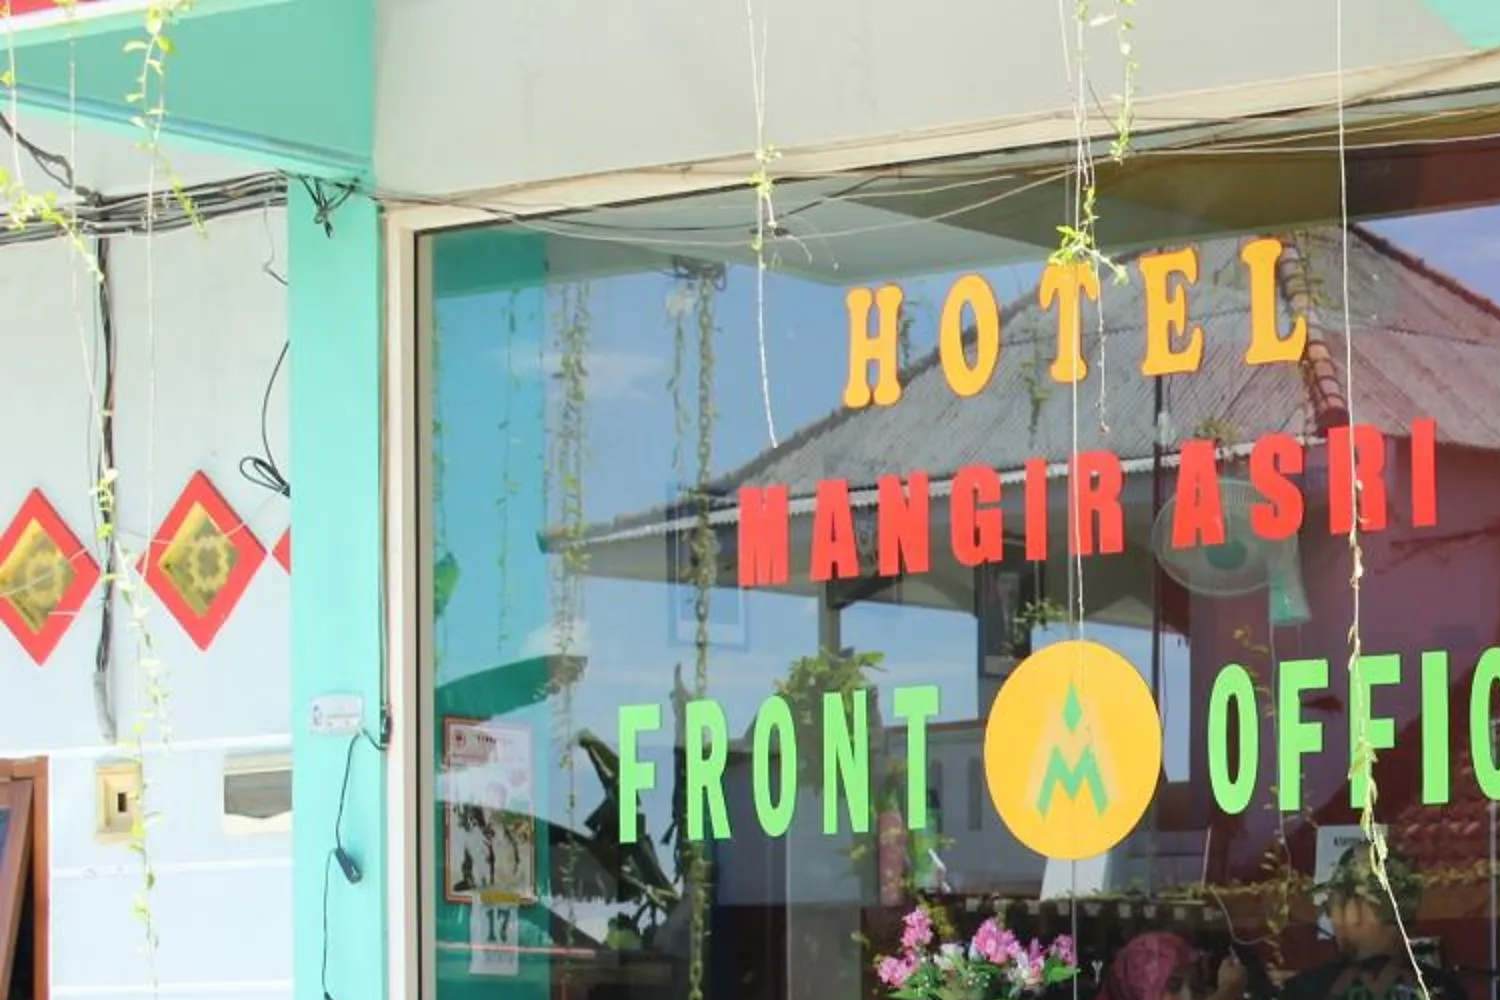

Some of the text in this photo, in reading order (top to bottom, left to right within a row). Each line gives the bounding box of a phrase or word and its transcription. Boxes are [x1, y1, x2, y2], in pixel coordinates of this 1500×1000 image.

[844, 236, 1308, 408] HOTEL
[738, 419, 1438, 587] MANGIR ASRI
[618, 684, 940, 843] FRONT
[486, 907, 511, 944] 17
